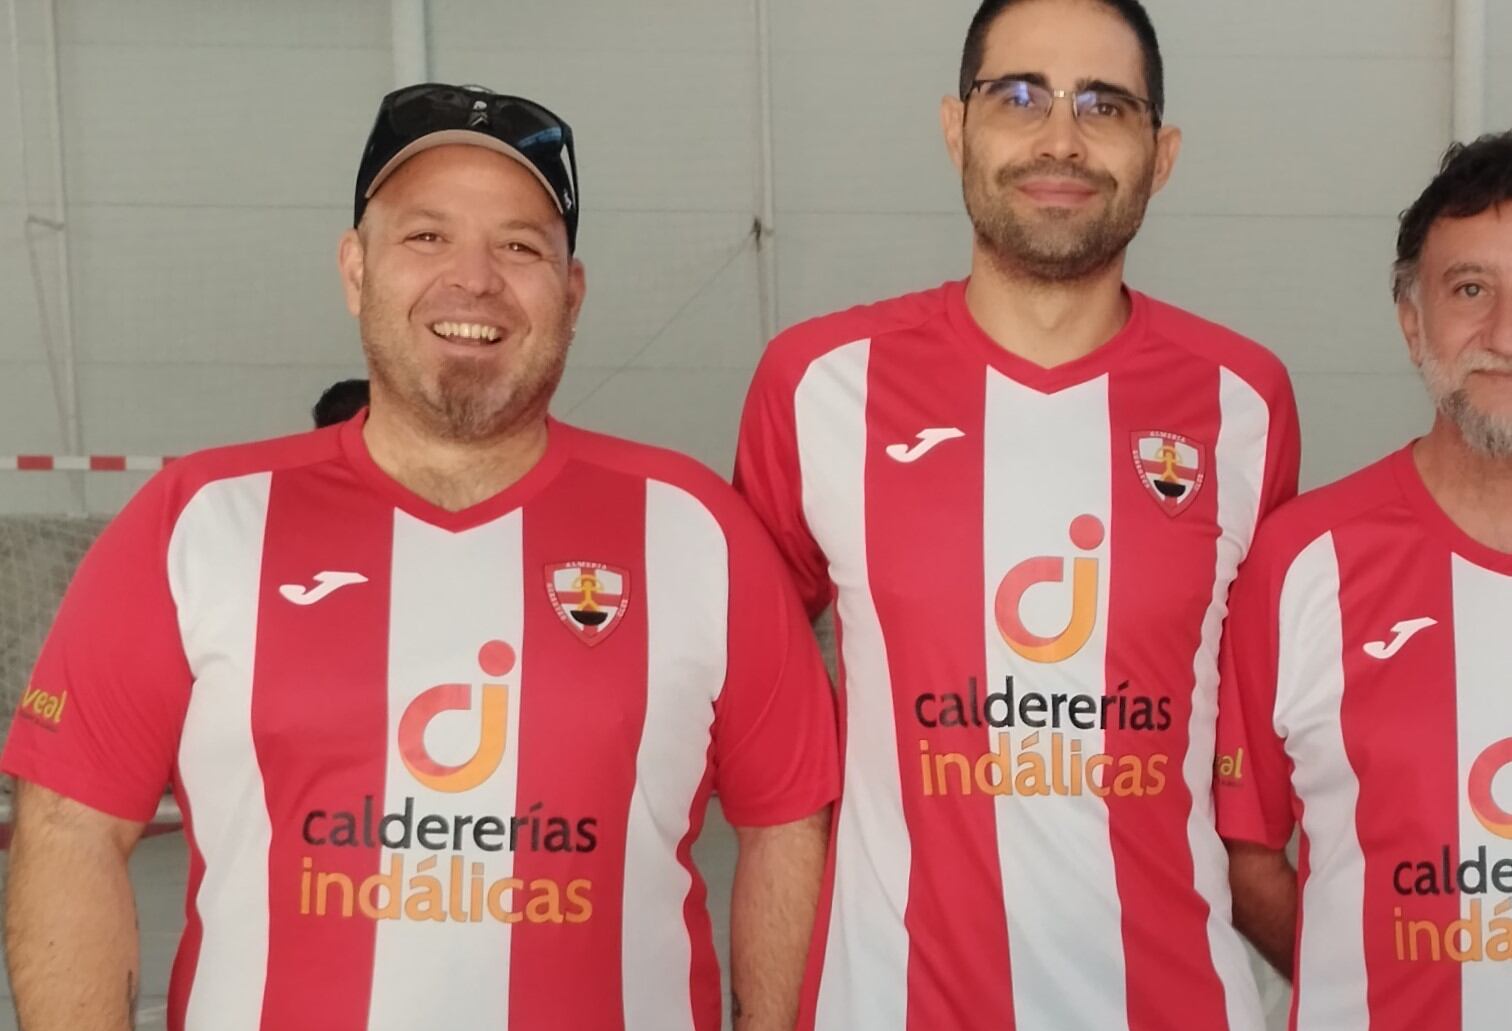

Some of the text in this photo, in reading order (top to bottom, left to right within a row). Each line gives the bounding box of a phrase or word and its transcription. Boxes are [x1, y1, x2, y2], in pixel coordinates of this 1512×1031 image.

[914, 674, 1172, 732] caldererías
[919, 731, 1169, 798] indálicas
[301, 794, 598, 854] caldererías
[299, 853, 594, 924] indálicas
